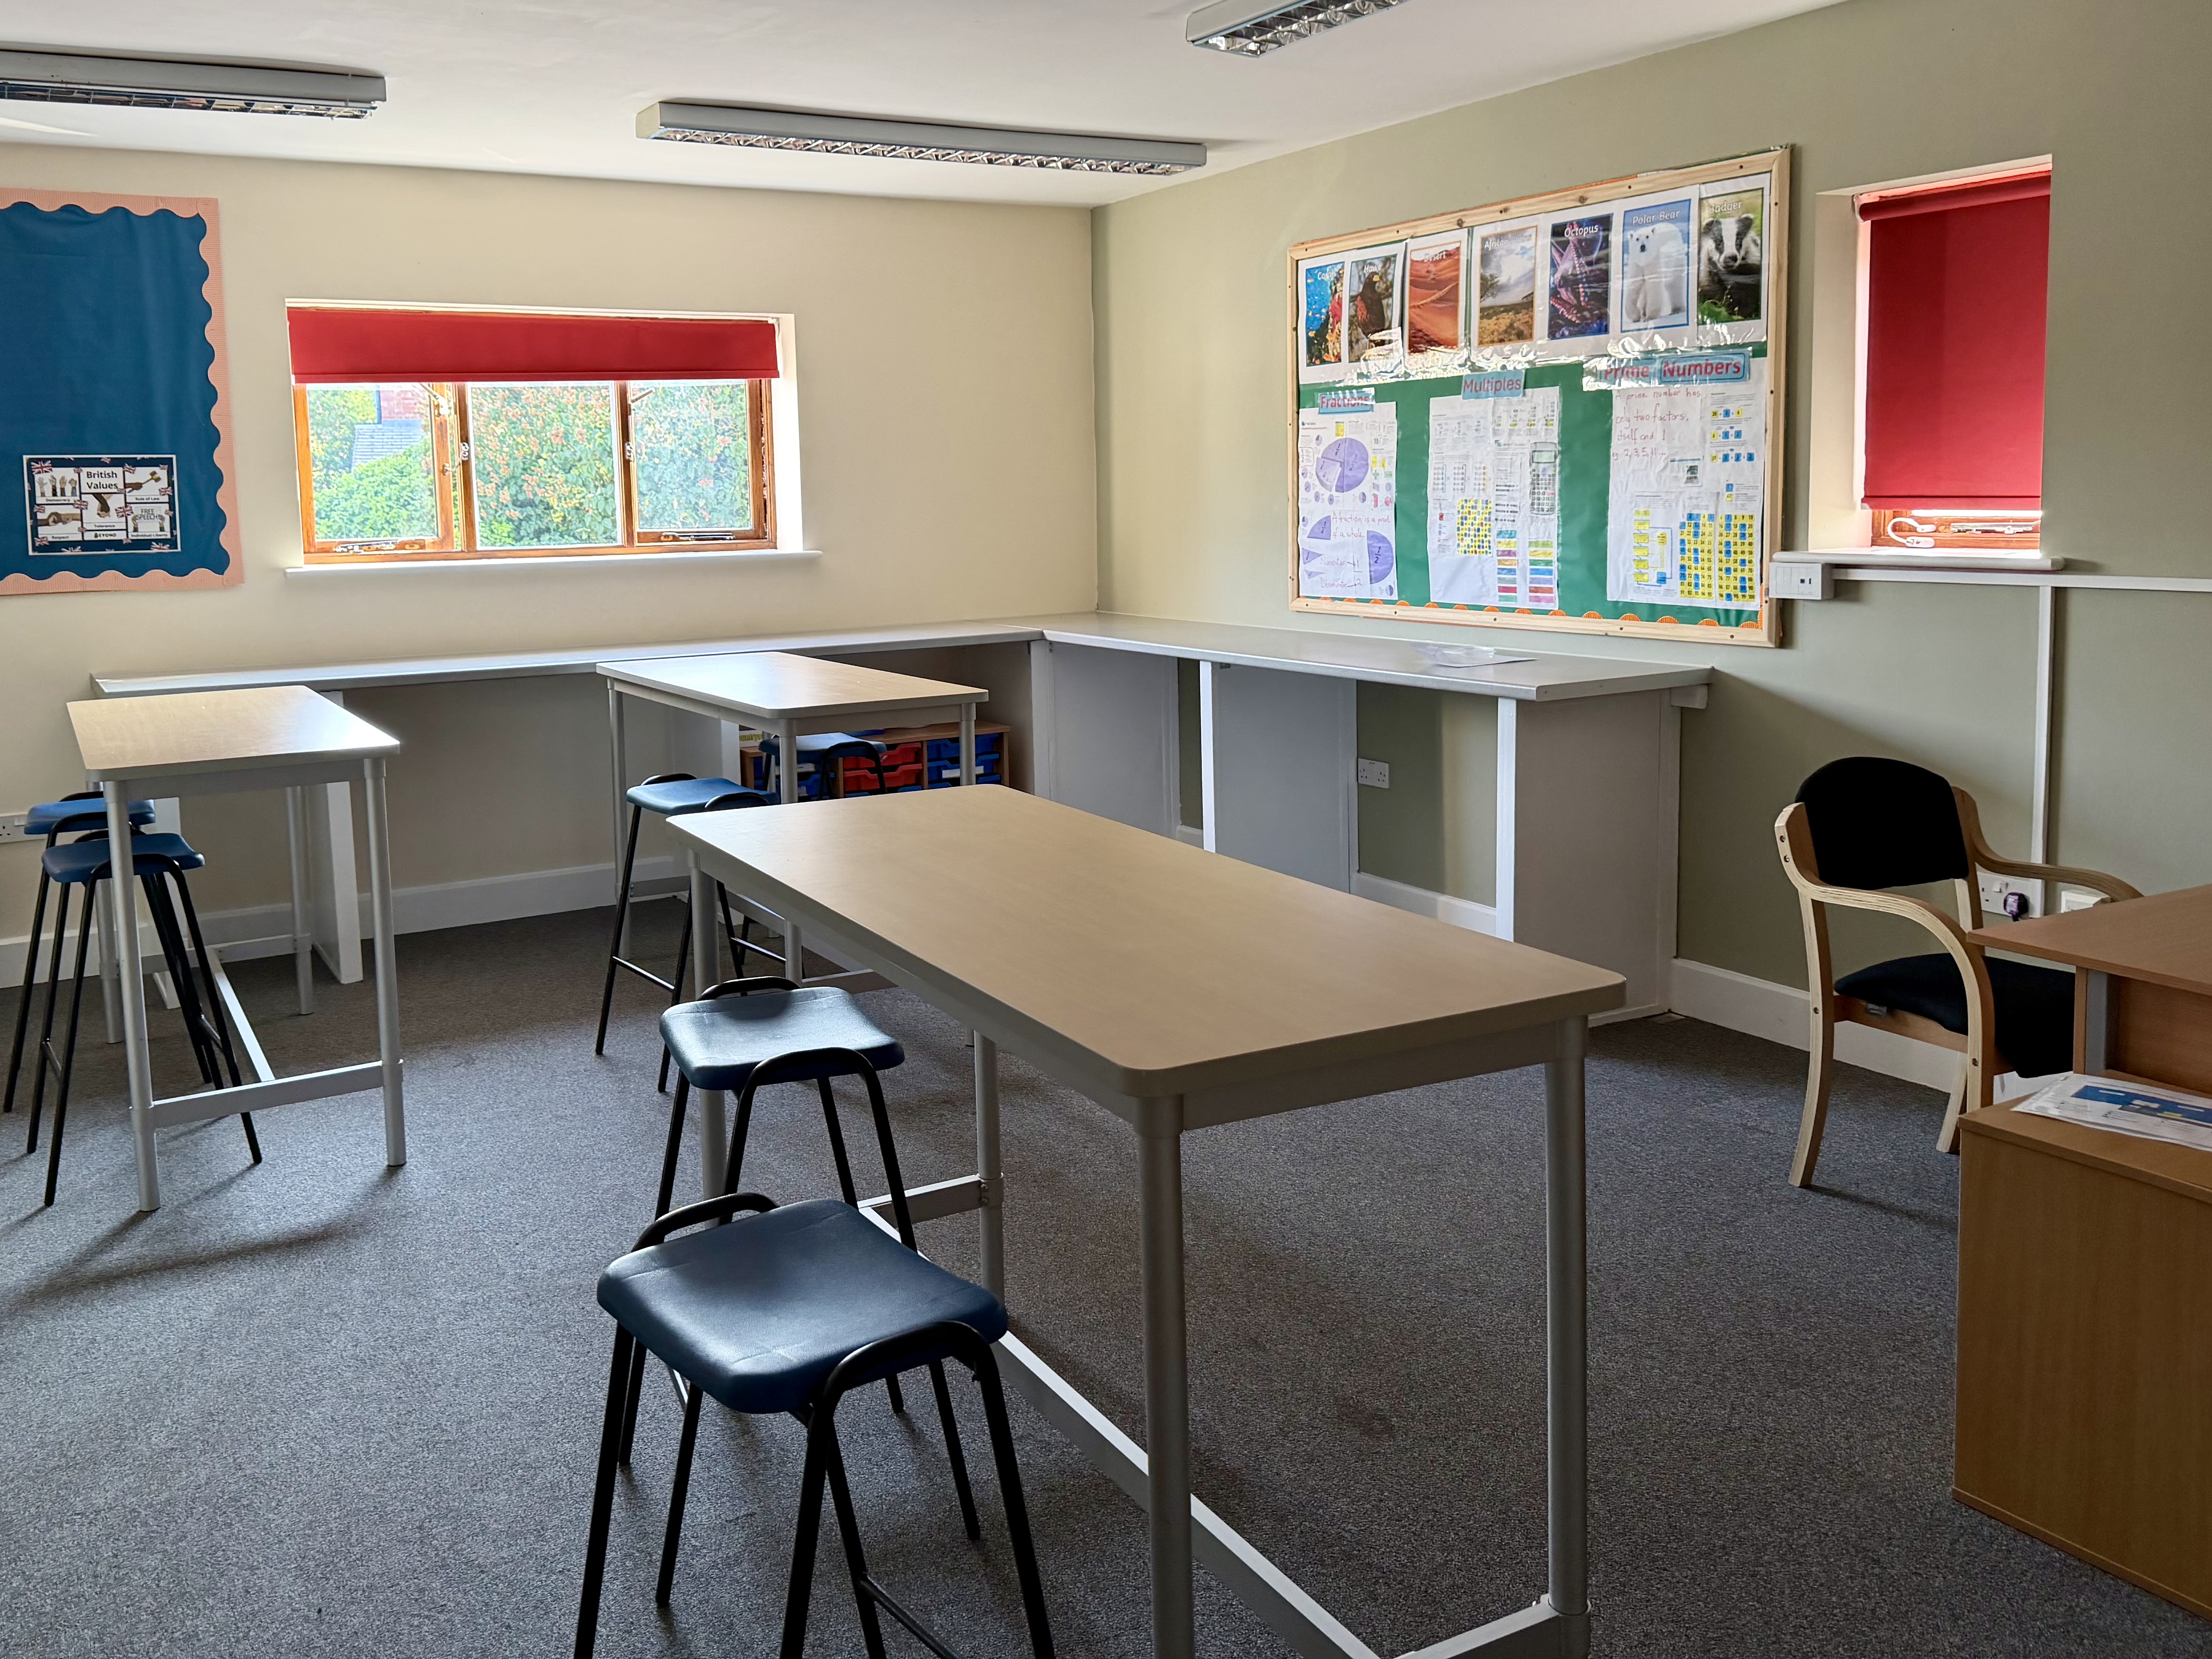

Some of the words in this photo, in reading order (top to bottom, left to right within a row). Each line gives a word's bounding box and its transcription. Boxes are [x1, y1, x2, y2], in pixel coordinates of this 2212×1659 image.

[1632, 215, 1656, 226] Polar
[1659, 211, 1681, 222] Bear
[1564, 224, 1599, 238] Octopus
[1604, 364, 1650, 380] Prime
[1662, 359, 1741, 377] Numbers
[1463, 377, 1522, 394] Multiples
[1321, 396, 1369, 408] Fractions
[1616, 390, 1621, 399] A
[1626, 392, 1648, 405] prime
[1653, 389, 1681, 398] number
[1686, 388, 1701, 398] has
[1616, 406, 1630, 429] only
[1634, 409, 1650, 421] two
[1640, 432, 1654, 440] and
